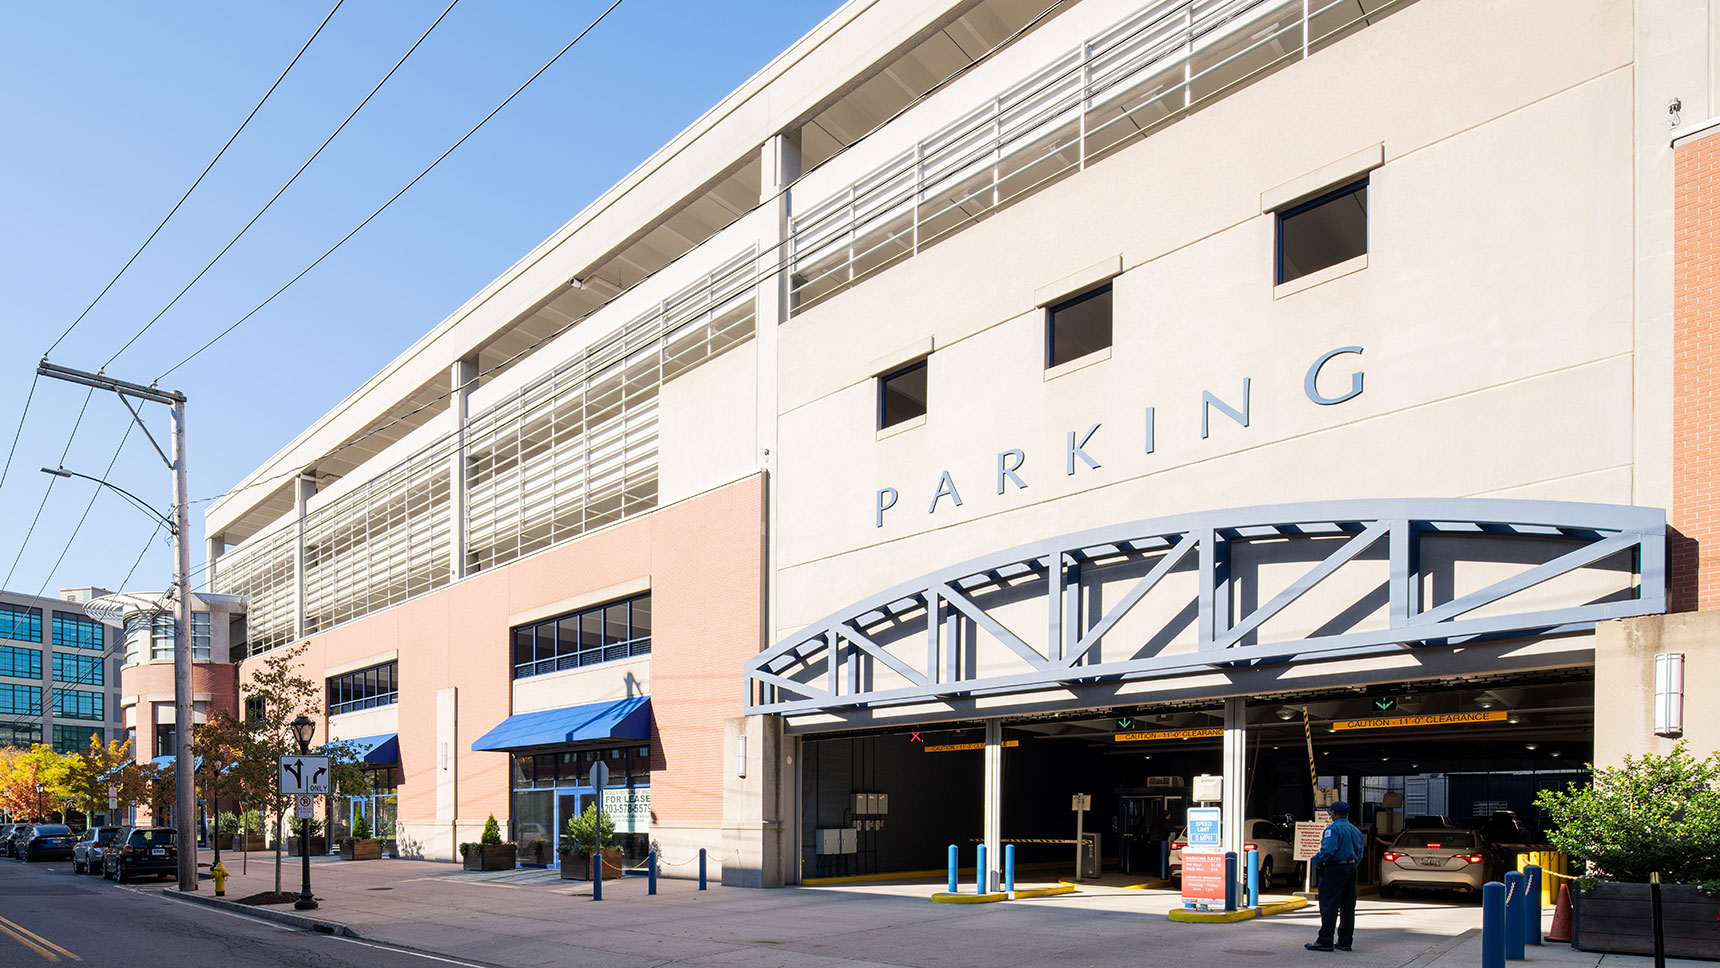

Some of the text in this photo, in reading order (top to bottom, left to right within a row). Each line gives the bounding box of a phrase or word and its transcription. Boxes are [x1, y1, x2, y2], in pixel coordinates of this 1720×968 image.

[876, 345, 1364, 528] PARKING
[1347, 719, 1390, 728] CAUTION
[1426, 712, 1490, 723] CLEARANCE
[1125, 732, 1157, 740] CAUTION
[1182, 728, 1224, 738] CLEARANC
[605, 795, 650, 803] FOR LEASE
